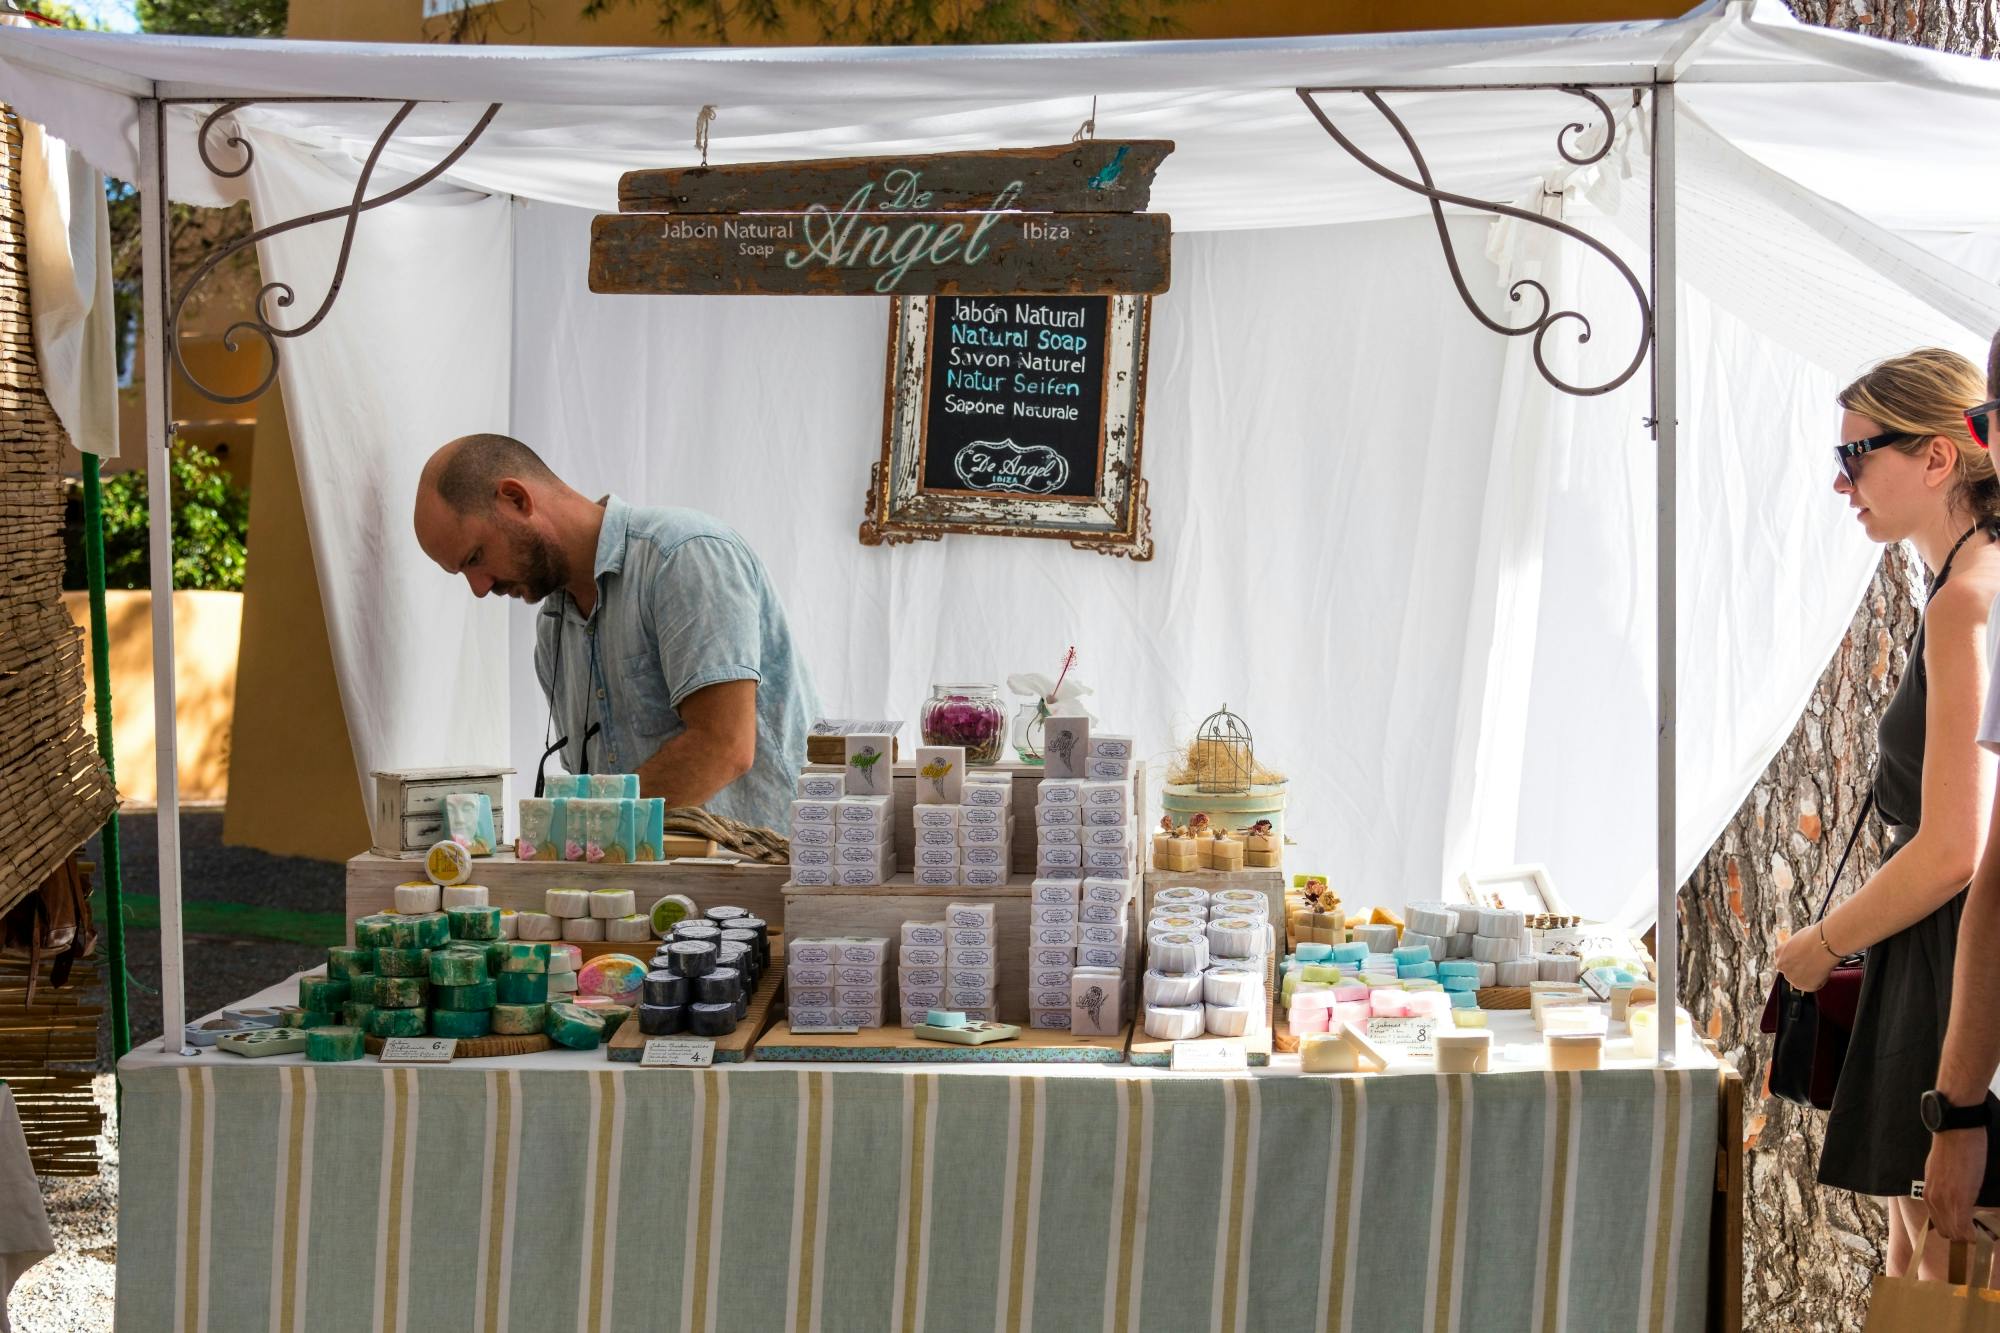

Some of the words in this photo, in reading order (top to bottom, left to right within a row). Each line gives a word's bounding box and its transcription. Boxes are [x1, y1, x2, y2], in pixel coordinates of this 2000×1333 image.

[879, 168, 933, 209] De
[661, 220, 718, 239] Jabón
[724, 220, 793, 239] Natural
[785, 180, 1024, 293] Angel
[1023, 222, 1070, 241] Ibiza
[739, 243, 774, 259] Soap
[951, 297, 1008, 324] Jabón
[1015, 303, 1085, 328] Natural
[951, 323, 1028, 347] Natural
[1037, 329, 1087, 355] Soap
[949, 346, 1010, 367] Savon
[1018, 352, 1086, 373] Naturel
[947, 368, 1006, 392] Natur
[1013, 373, 1080, 396] Seifen
[1013, 402, 1079, 421] Naturale
[970, 453, 996, 473] De
[998, 455, 1057, 486] Angel
